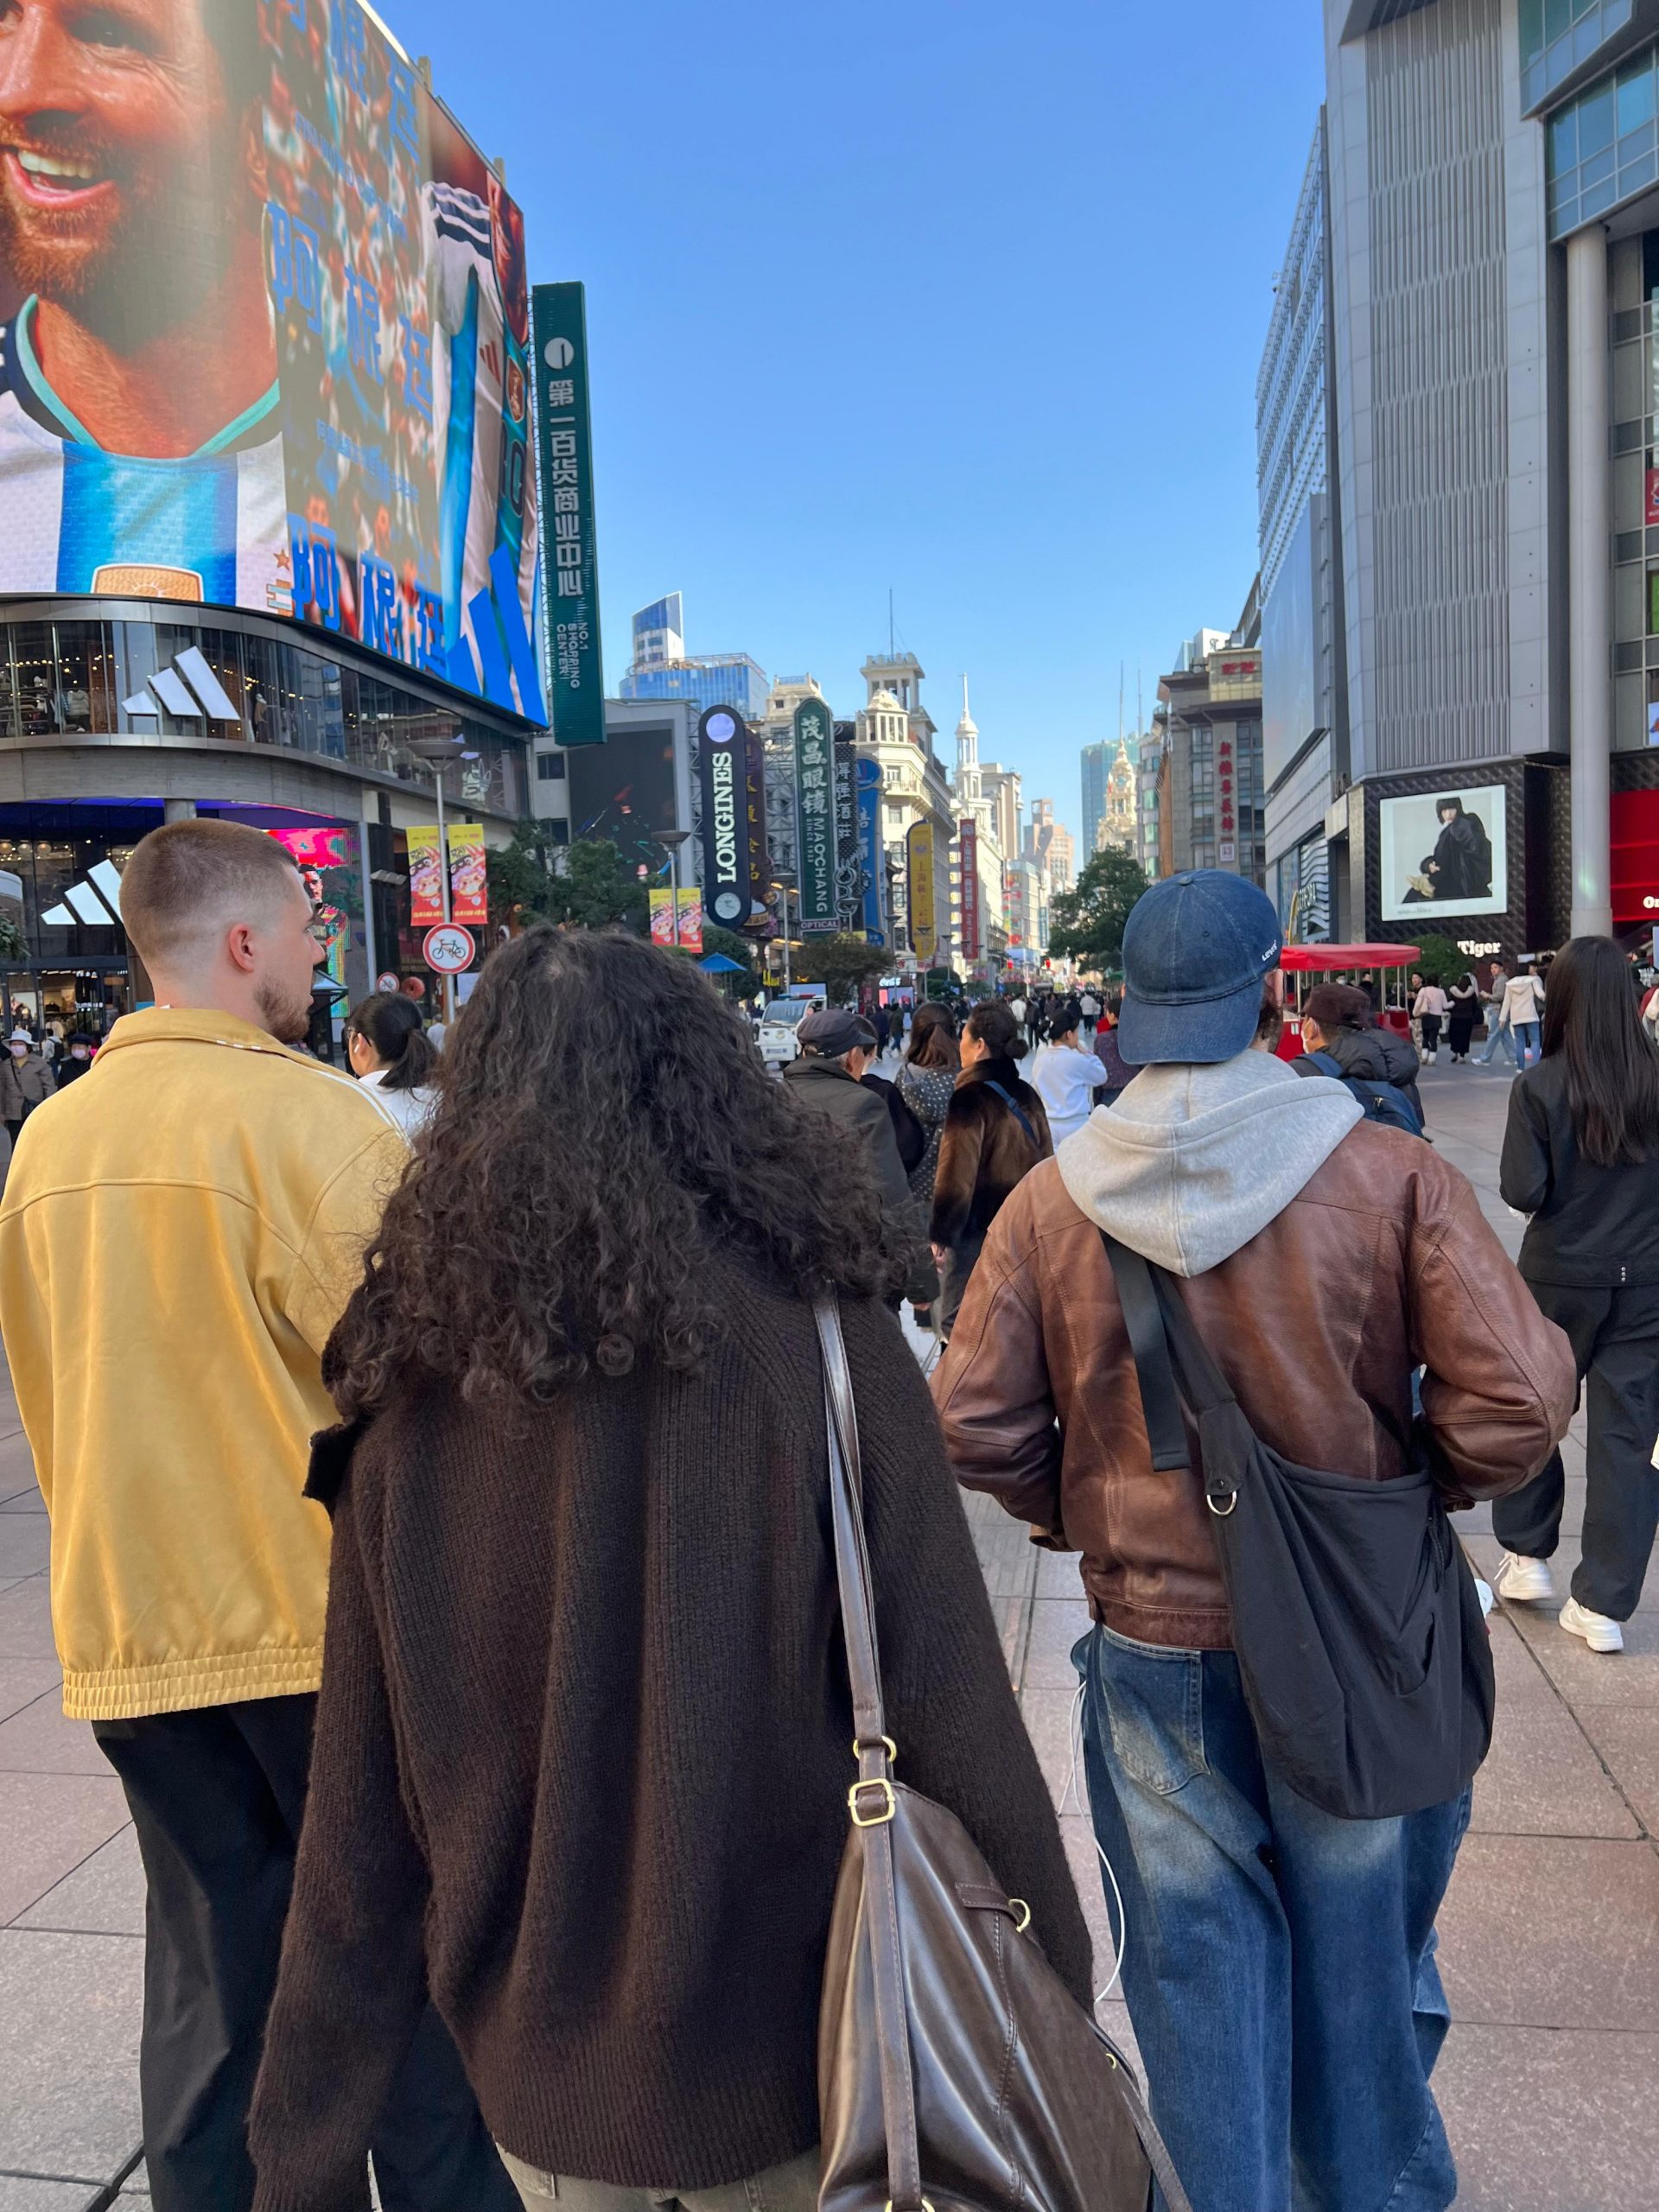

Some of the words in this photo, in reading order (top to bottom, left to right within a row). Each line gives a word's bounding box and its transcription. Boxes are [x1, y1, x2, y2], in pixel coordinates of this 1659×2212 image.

[267, 200, 433, 424] 阿根廷
[548, 378, 584, 597] 第一百货商业中心
[556, 624, 569, 675] CENTER
[567, 623, 581, 689] SHOPPING
[577, 622, 589, 650] NO.1
[800, 715, 828, 814] 茂昌眼镜
[712, 752, 737, 883] LONGINES
[813, 817, 828, 912] MAOCHANG
[801, 920, 838, 929] OPTICAL
[1458, 940, 1502, 957] Tiger
